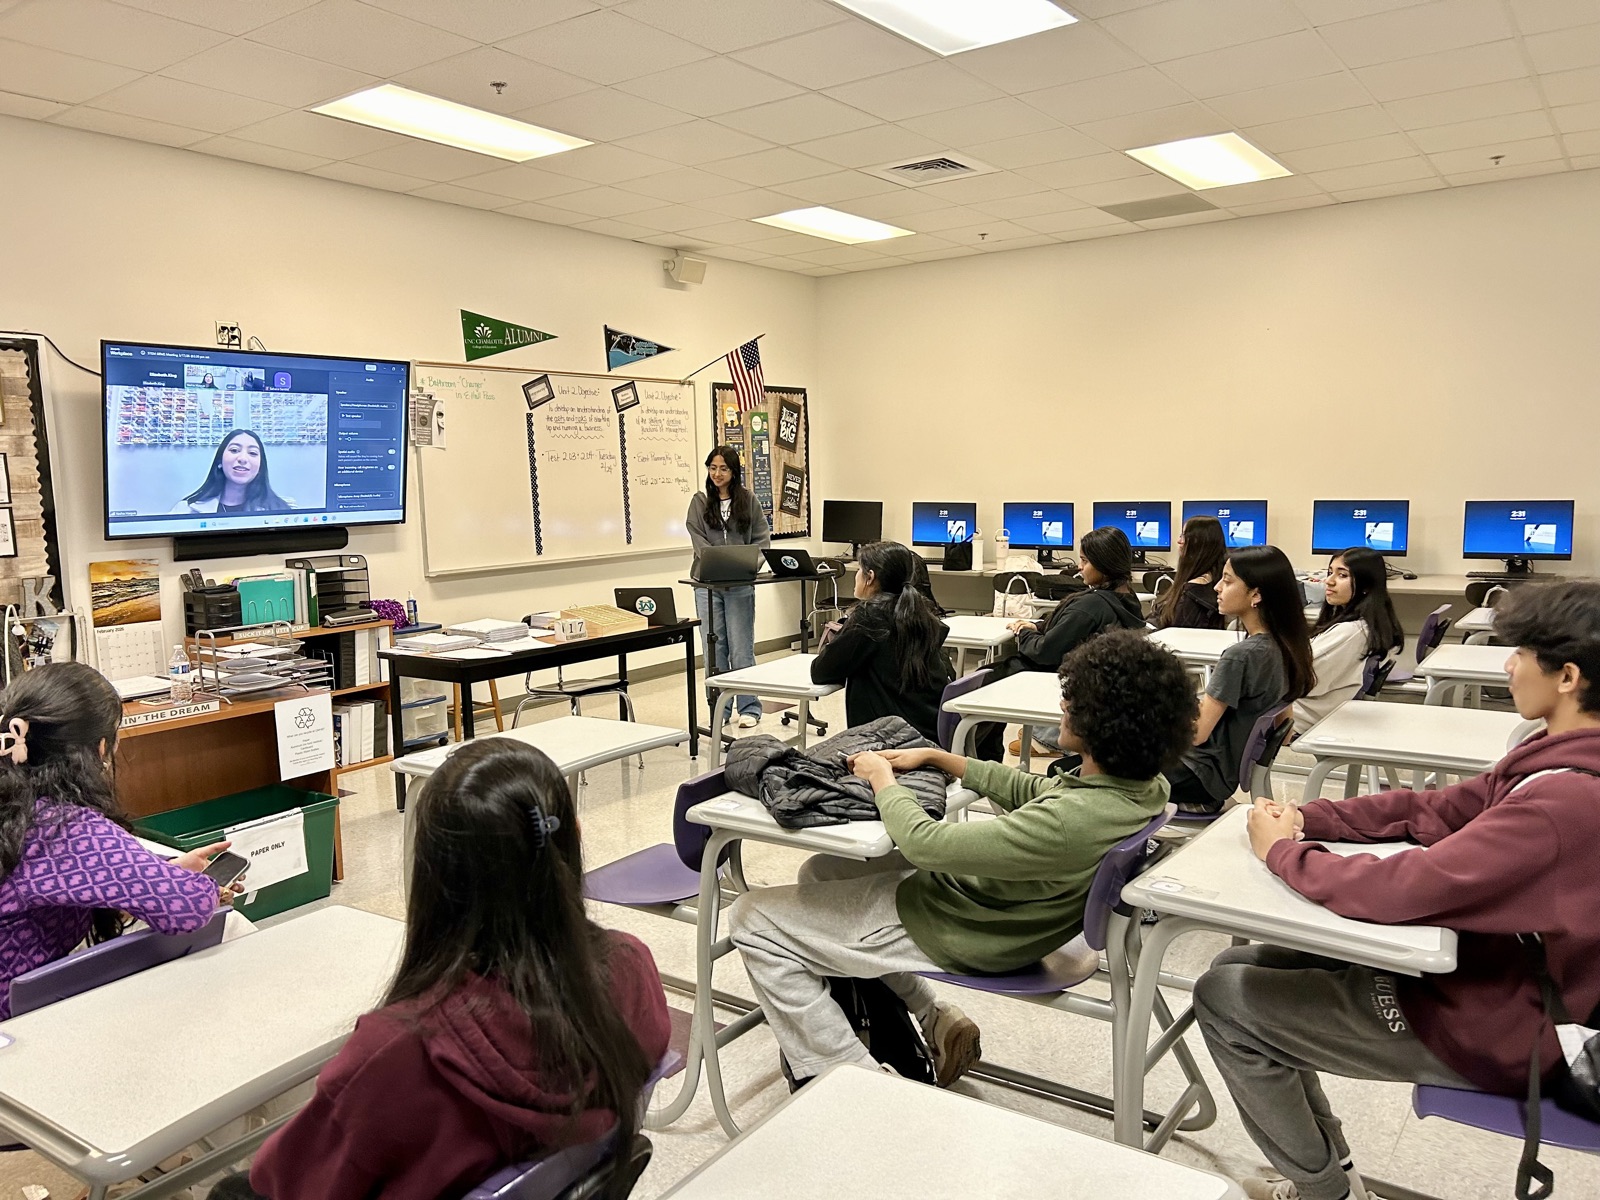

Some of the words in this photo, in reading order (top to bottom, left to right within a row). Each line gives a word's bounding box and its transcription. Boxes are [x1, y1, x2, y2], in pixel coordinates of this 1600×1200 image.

[504, 327, 543, 346] ALUMNI
[280, 378, 286, 386] S
[545, 450, 560, 462] Test
[20, 574, 58, 618] K
[124, 716, 141, 725] IN'
[144, 712, 167, 721] THE
[170, 704, 210, 716] DREAM
[250, 846, 270, 857] PAPER
[270, 841, 286, 851] ONLY
[1374, 976, 1406, 1033] GUESS
